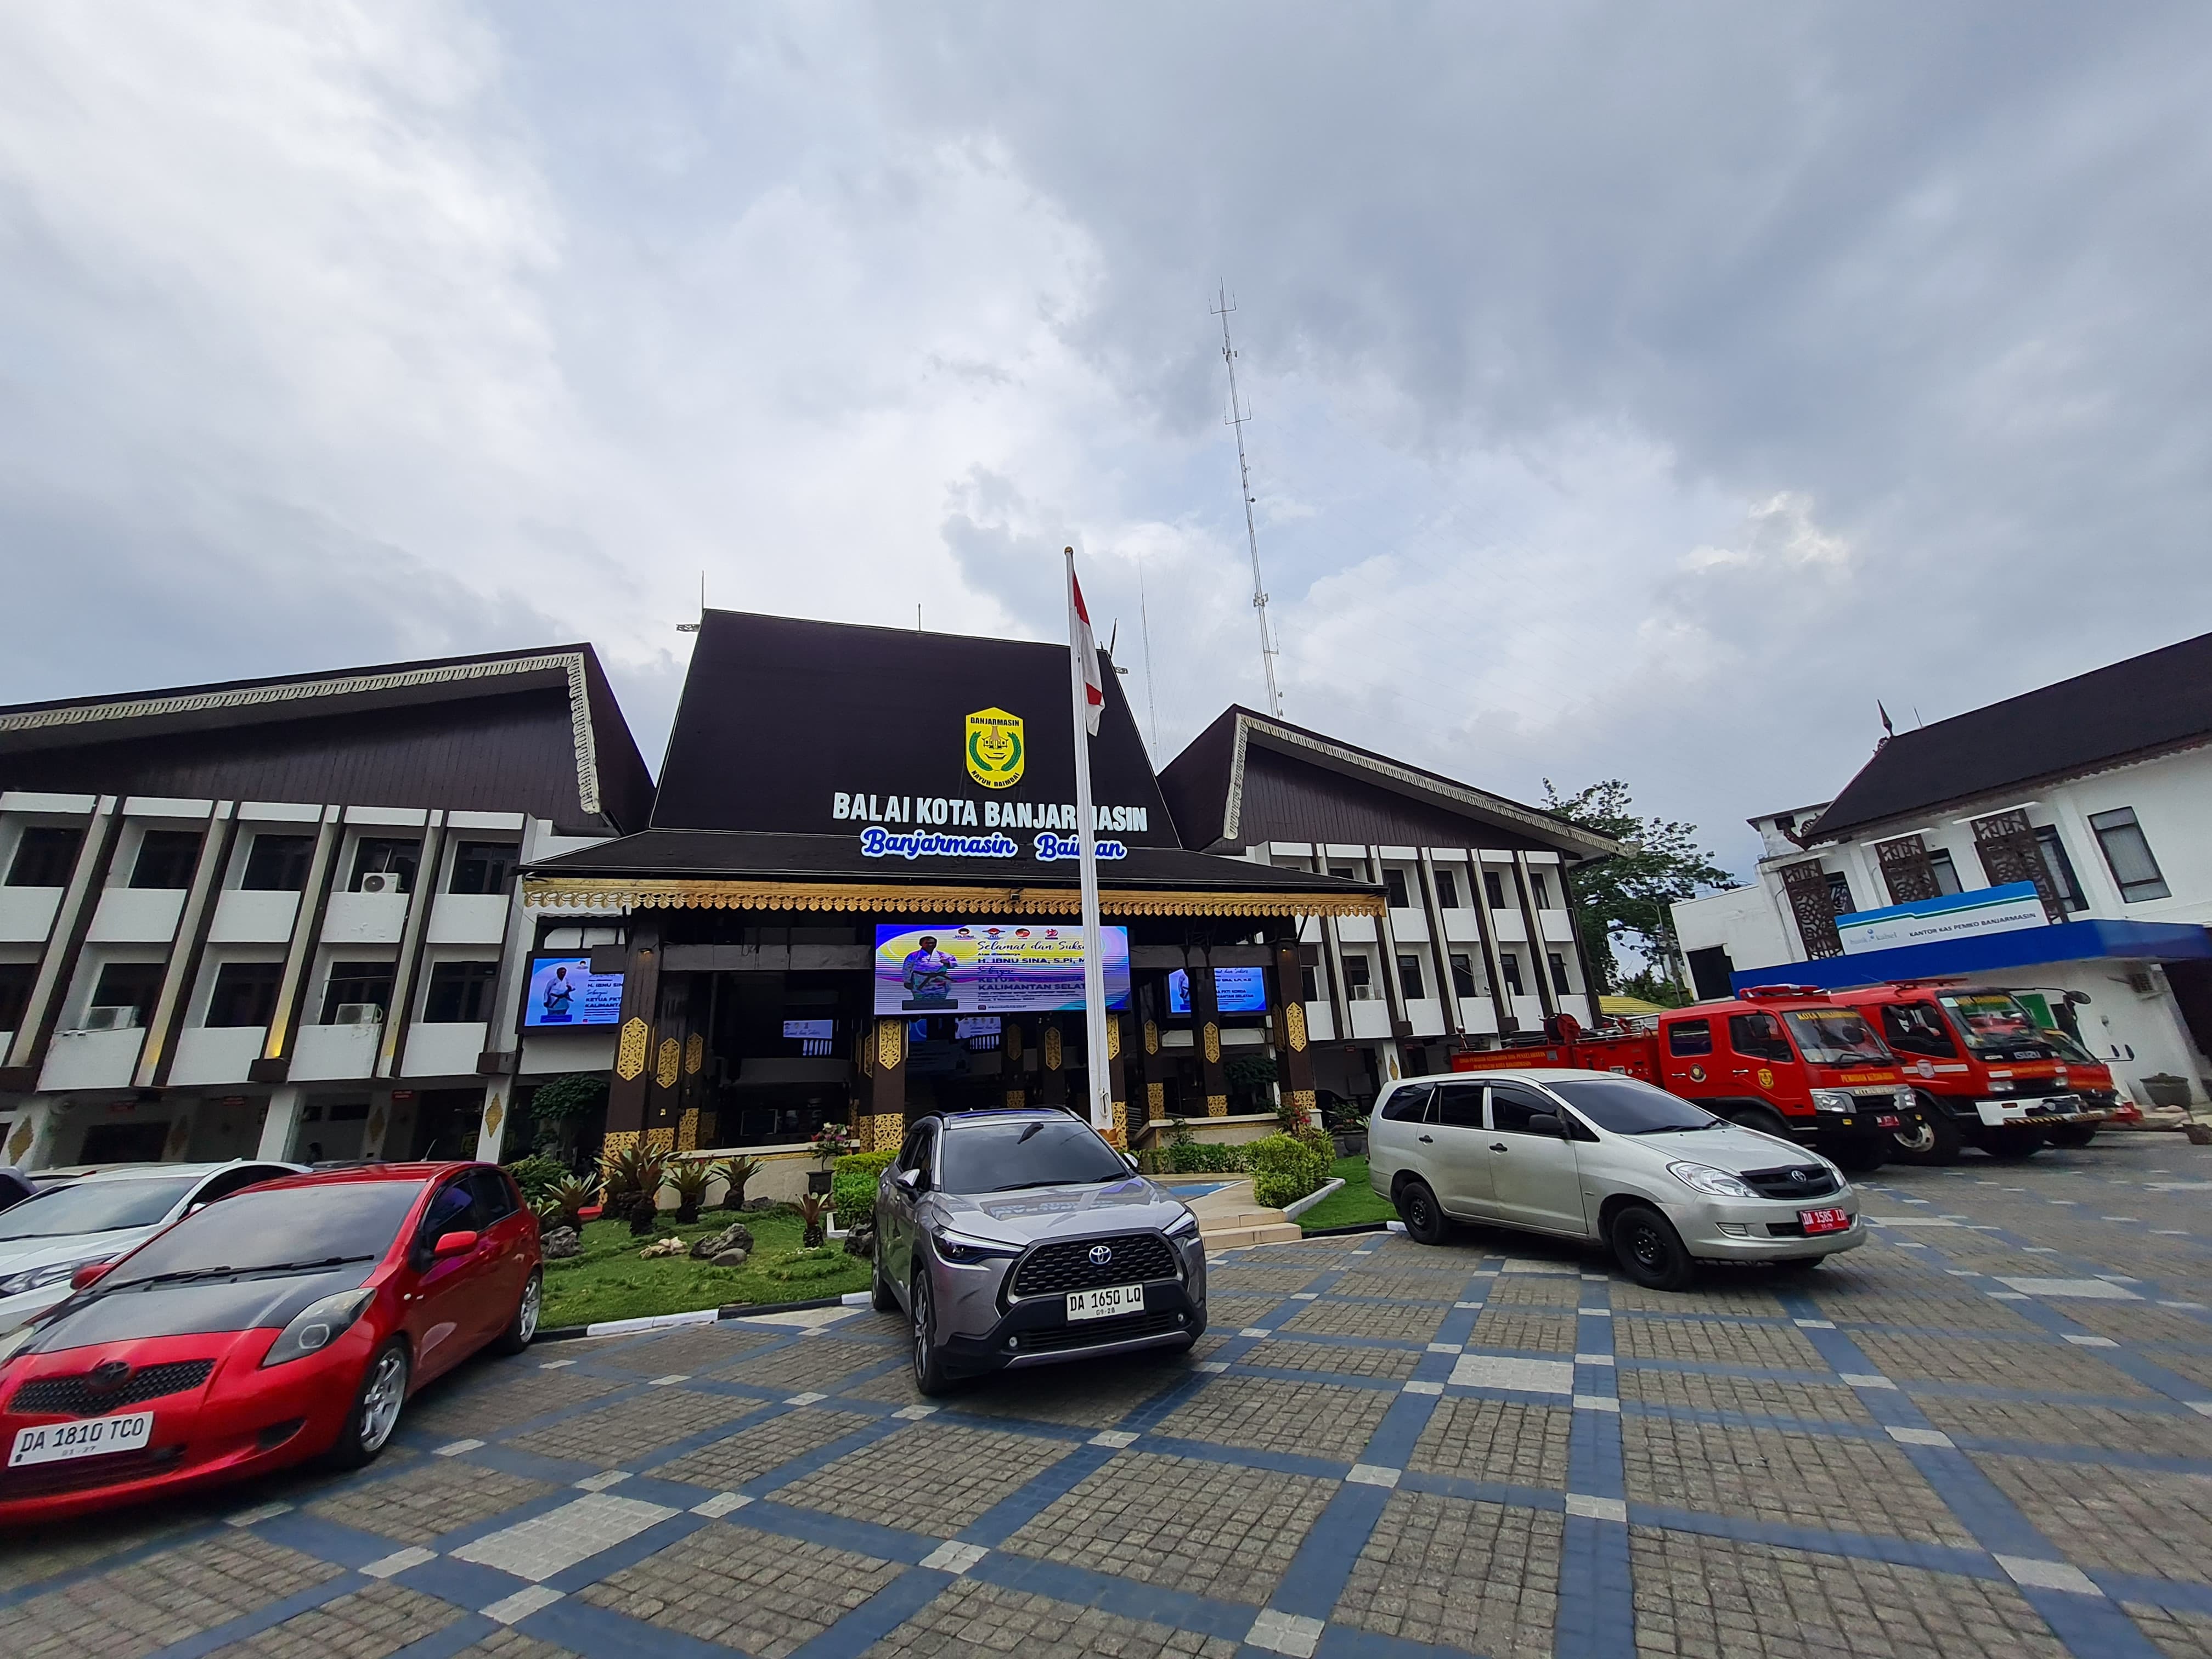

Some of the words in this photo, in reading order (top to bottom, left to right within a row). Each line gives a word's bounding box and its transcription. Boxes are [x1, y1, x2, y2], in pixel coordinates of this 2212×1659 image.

[970, 717, 1019, 726] BANJARMASIN
[994, 772, 1020, 787] BAIMBAI
[833, 792, 910, 822] BALAI
[917, 797, 978, 826] KOTA
[861, 827, 1017, 859] Banjarmasin
[1035, 833, 1126, 860] Baian
[1909, 928, 1937, 936] KANTOR
[1981, 913, 2036, 926] BANJARMASIN
[977, 941, 1026, 951] Selamat
[1031, 941, 1054, 951] dan
[2013, 1050, 2041, 1059] ISUZU
[1803, 1212, 1814, 1225] DA
[1814, 1210, 1833, 1223] 1585
[1070, 1295, 1085, 1311] DA
[1091, 1290, 1120, 1308] 1650
[1126, 1288, 1141, 1303] LQ
[20, 1431, 45, 1452] DA
[53, 1423, 103, 1447] 1810
